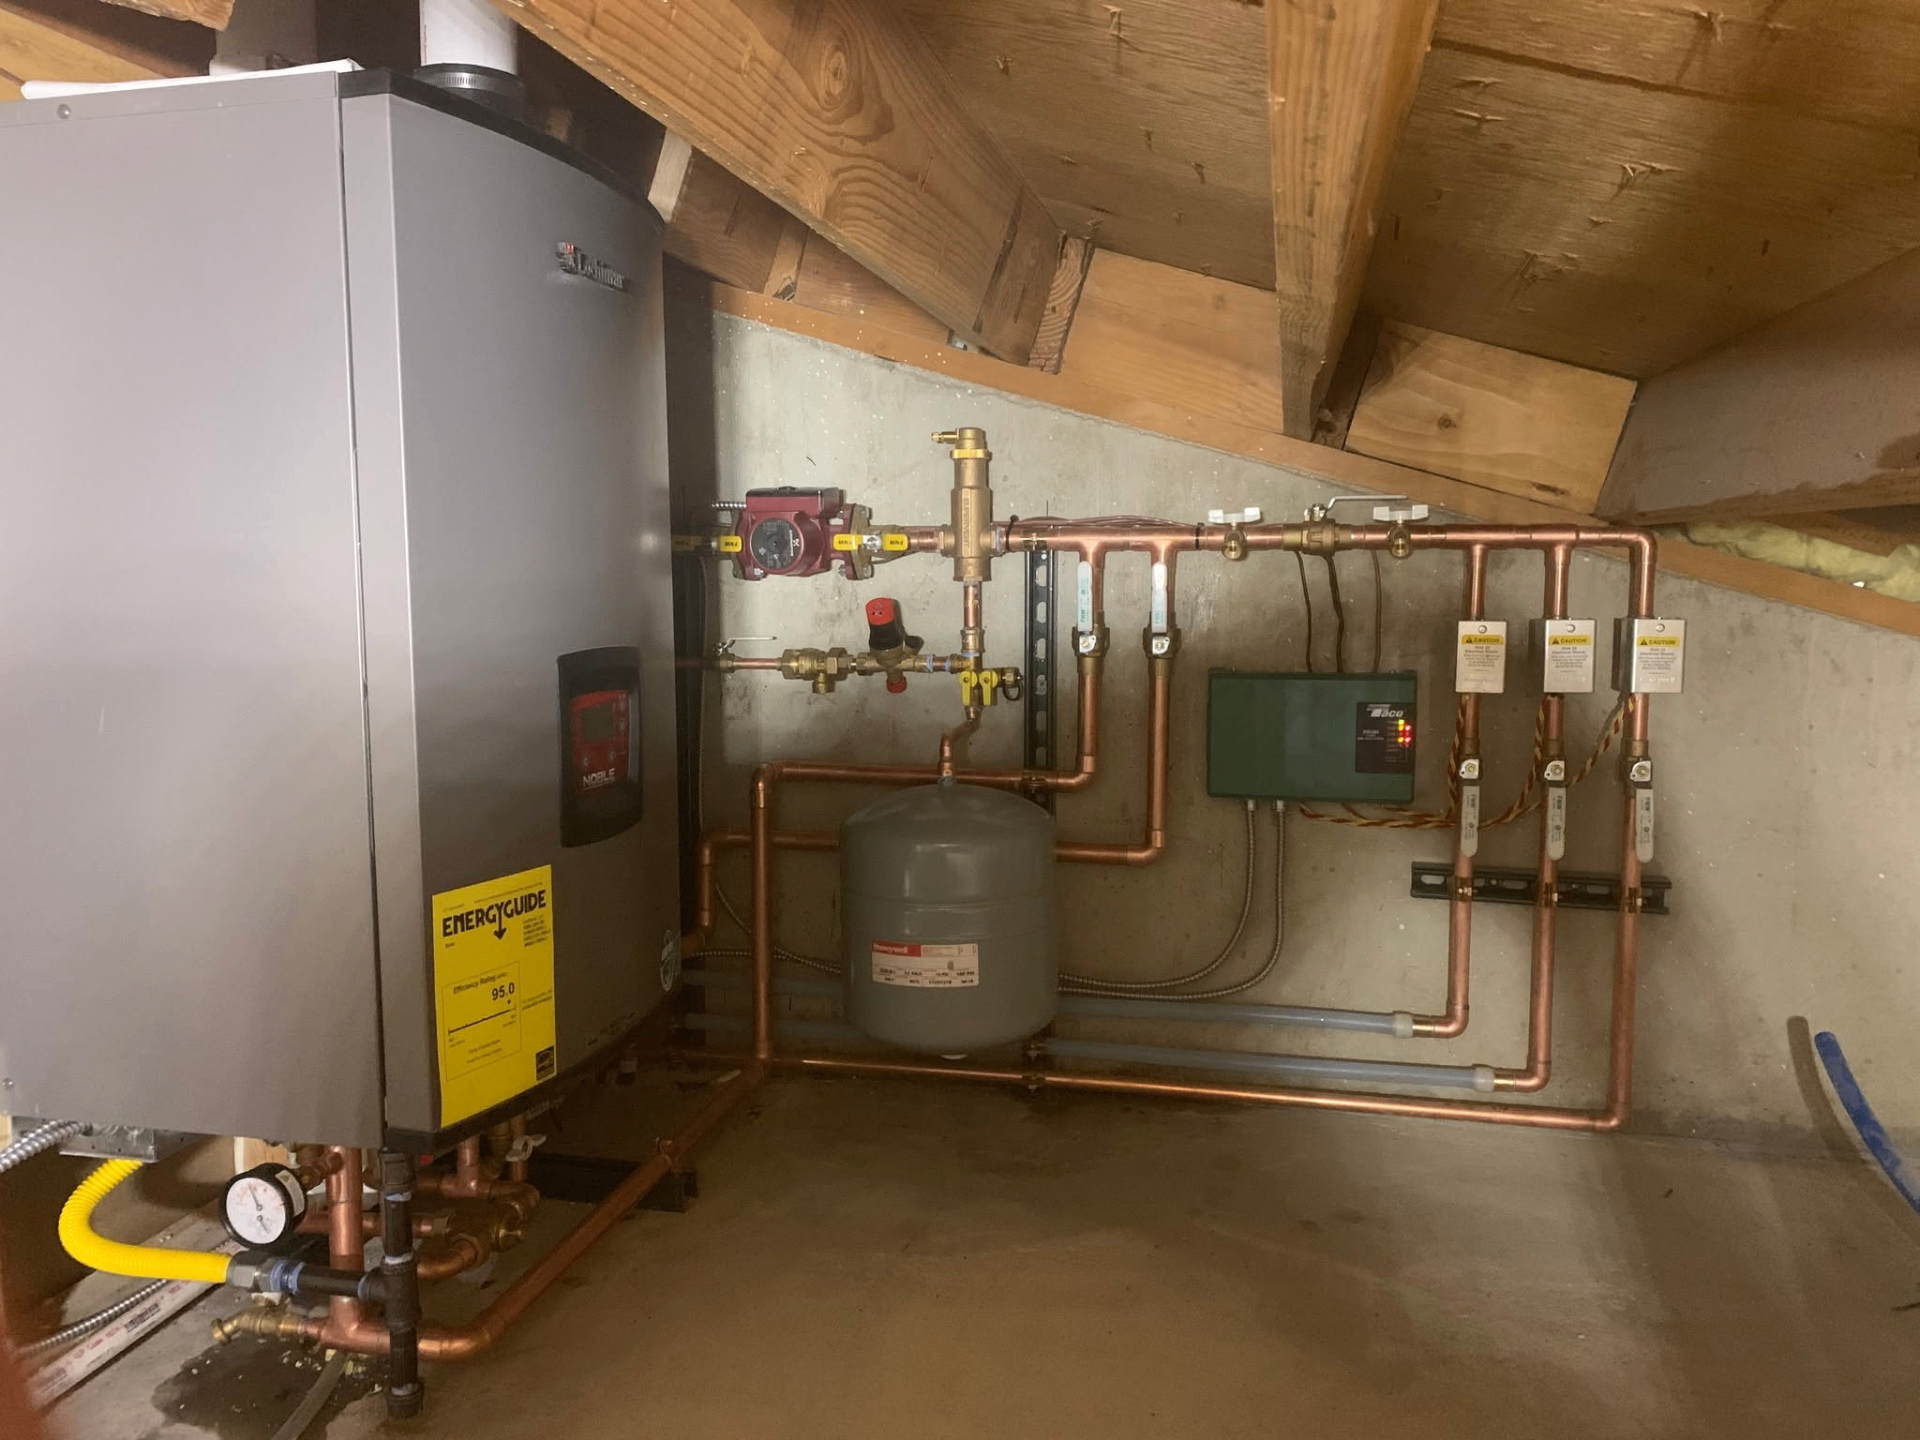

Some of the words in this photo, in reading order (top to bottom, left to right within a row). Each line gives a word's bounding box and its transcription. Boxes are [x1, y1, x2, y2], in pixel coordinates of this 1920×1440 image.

[583, 768, 616, 788] NOBLE
[442, 889, 547, 938] ENERGYGUIDE
[491, 982, 515, 1001] 95.0
